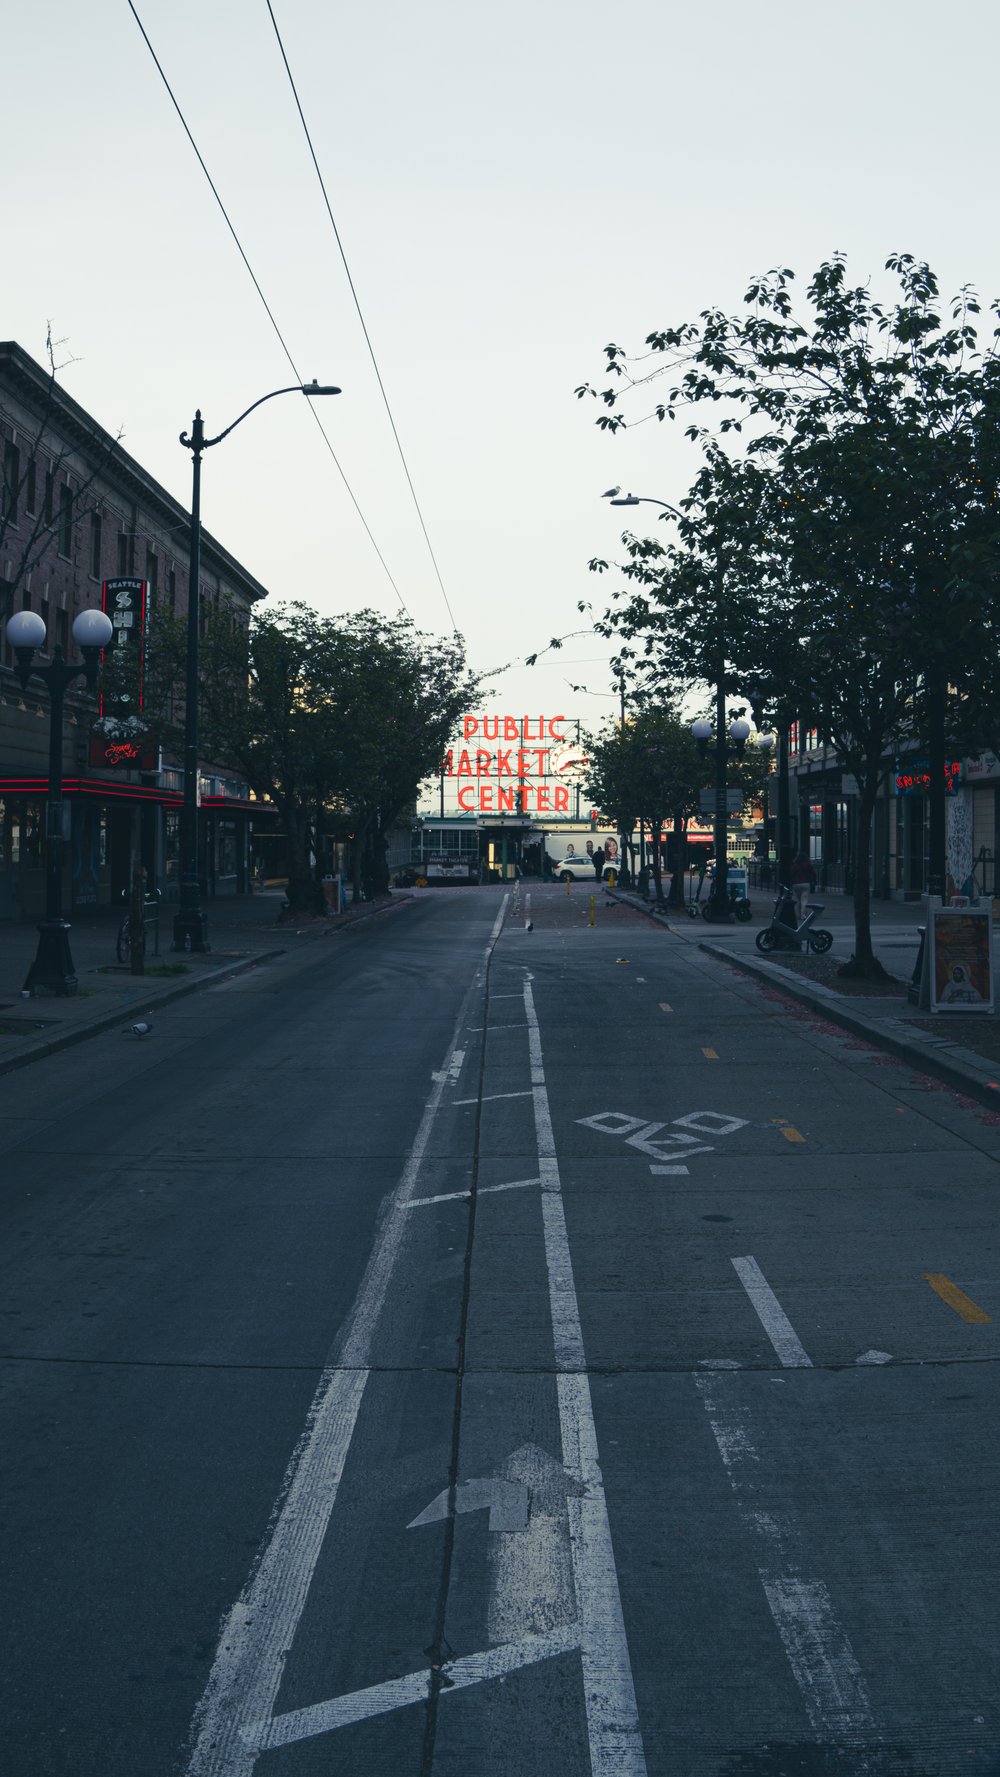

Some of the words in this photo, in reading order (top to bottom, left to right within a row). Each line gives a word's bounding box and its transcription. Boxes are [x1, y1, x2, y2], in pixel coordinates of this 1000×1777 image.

[107, 580, 142, 591] SEATTLE
[464, 714, 565, 741] PUBLIC
[457, 785, 570, 812] CENTER
